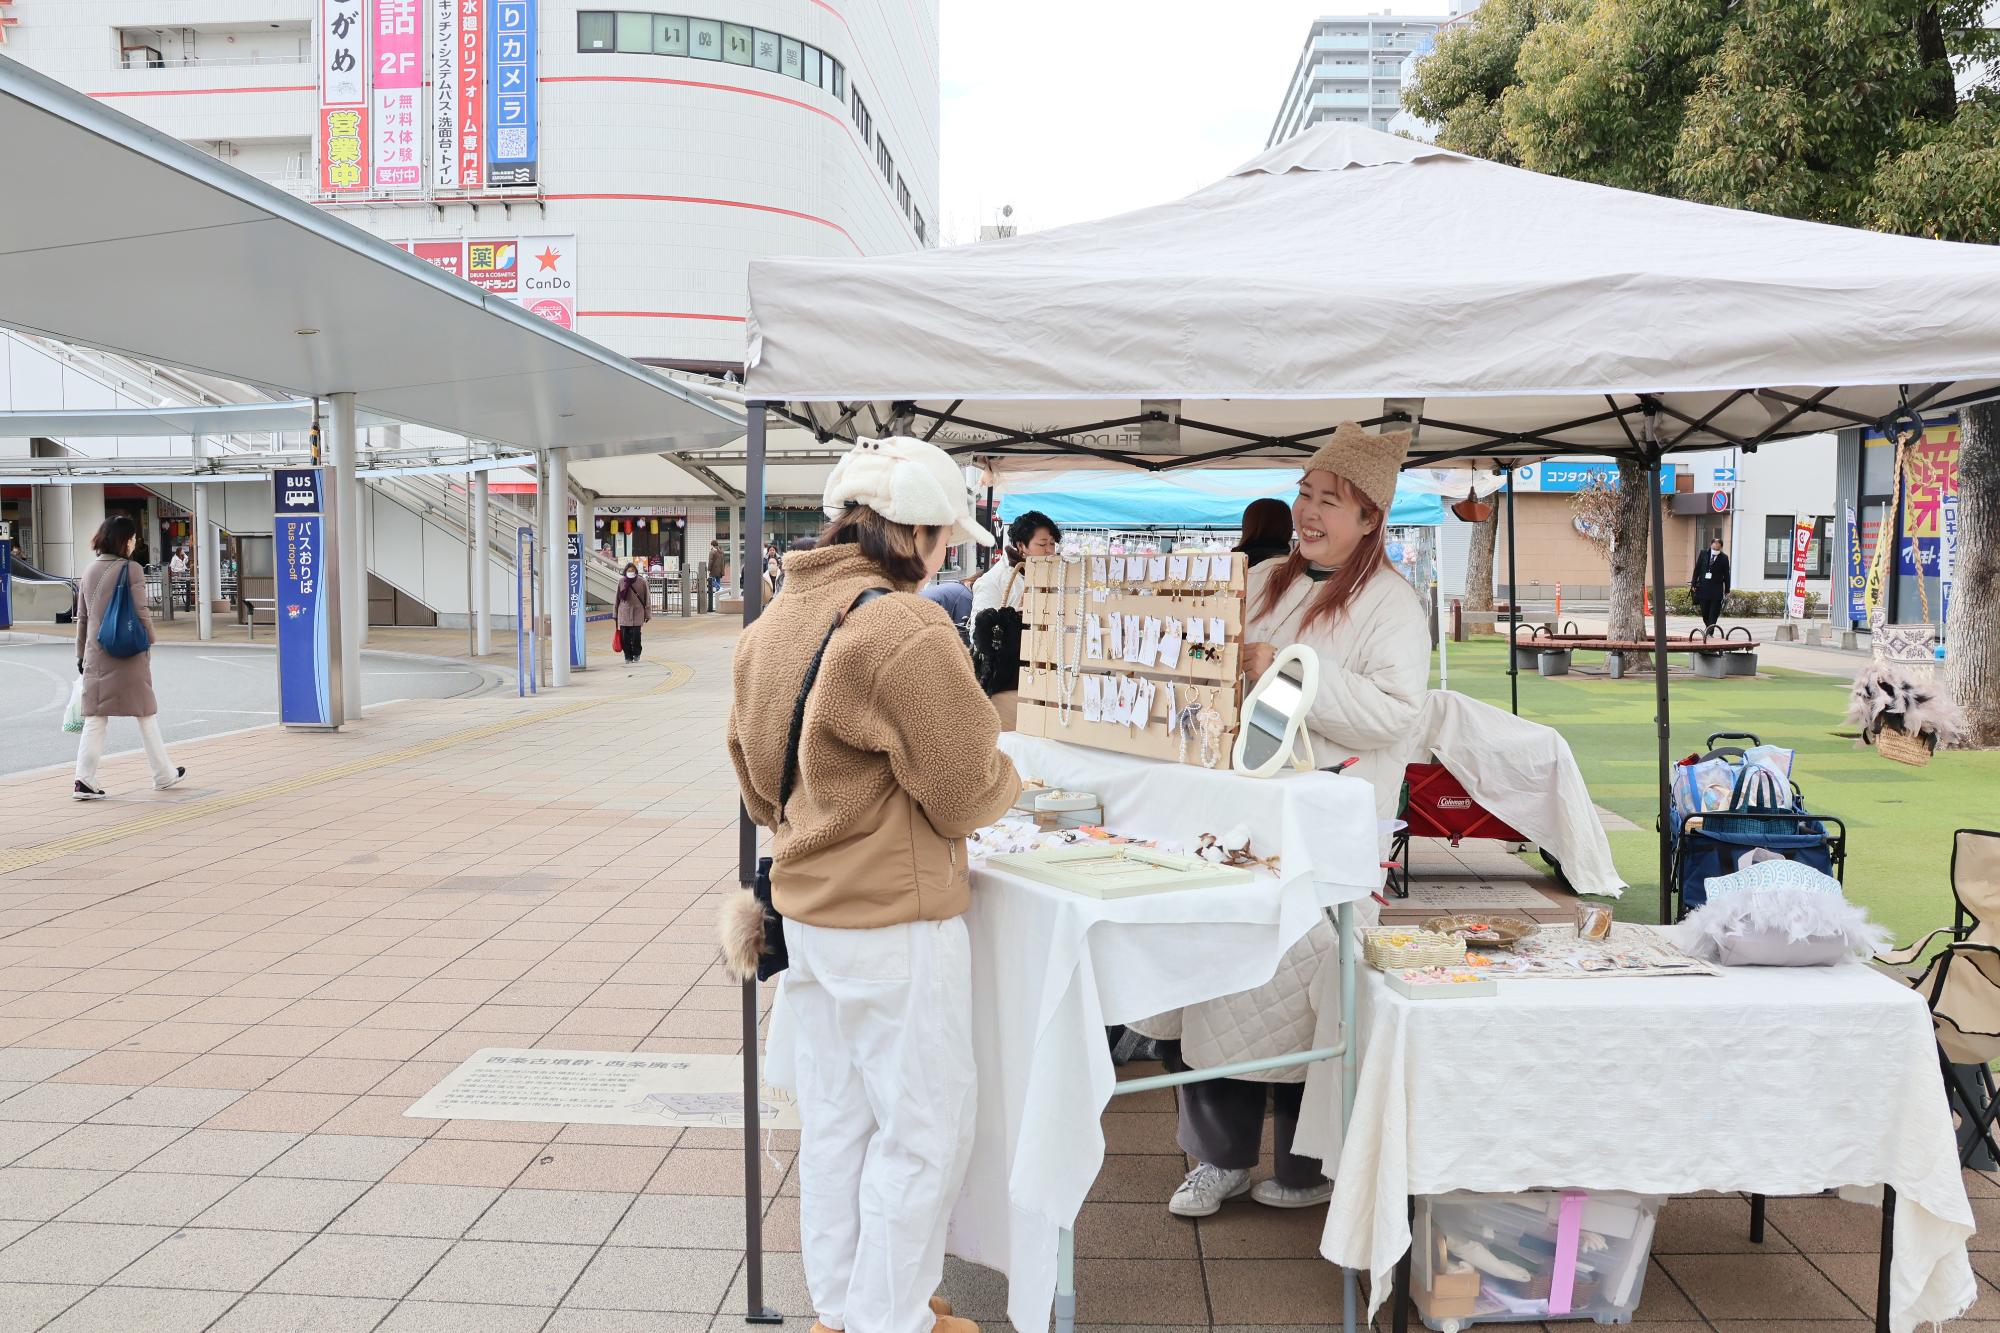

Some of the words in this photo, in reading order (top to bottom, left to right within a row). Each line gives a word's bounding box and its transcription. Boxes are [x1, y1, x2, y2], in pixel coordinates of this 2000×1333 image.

[380, 53, 415, 74] 2F
[384, 95, 396, 162] レッスン
[399, 95, 413, 162] 無料体験
[328, 111, 361, 187] 営業中
[379, 169, 416, 182] 受付中
[472, 248, 492, 268] 薬
[525, 278, 571, 289] CanDo
[286, 476, 311, 487] BUS
[288, 523, 296, 541] Bus
[288, 545, 298, 580] drop-off
[298, 522, 312, 594] バスおりば
[1440, 797, 1465, 807] Coleman
